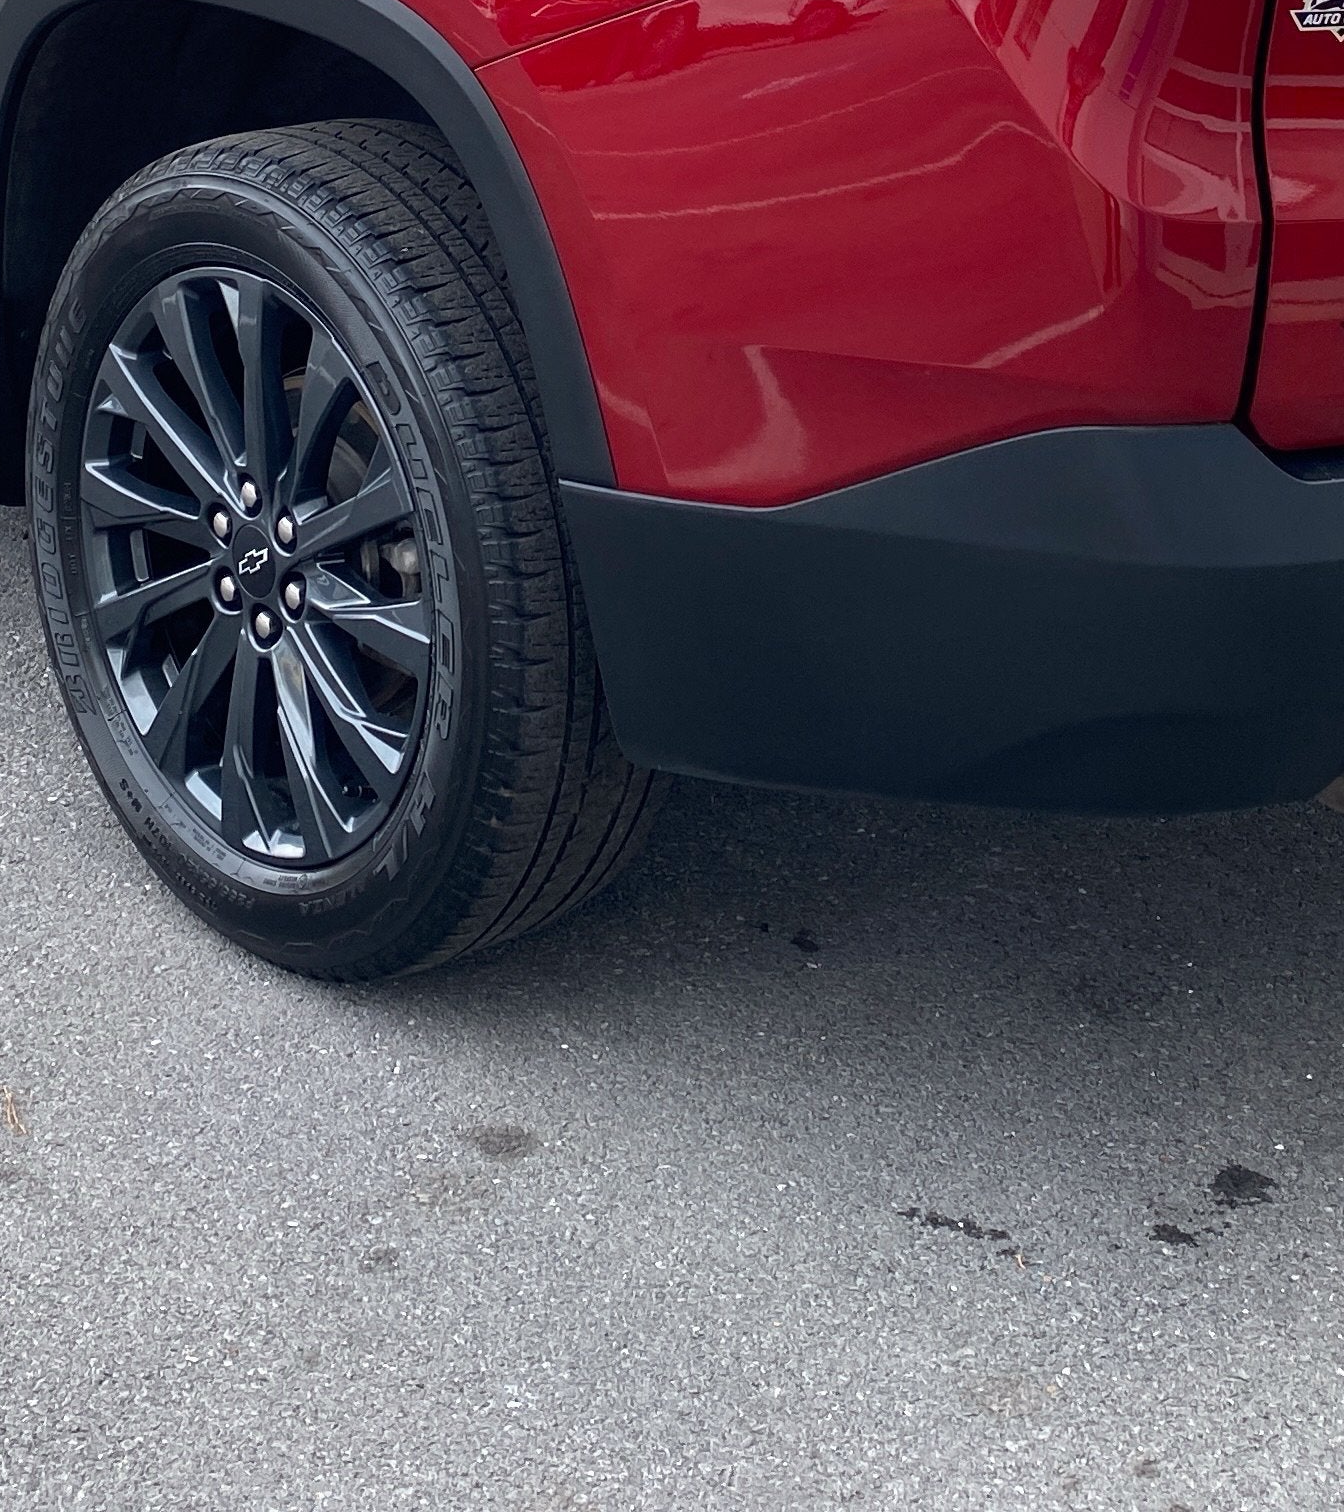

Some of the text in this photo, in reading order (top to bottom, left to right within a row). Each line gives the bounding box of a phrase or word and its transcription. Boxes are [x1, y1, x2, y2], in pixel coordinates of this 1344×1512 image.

[1303, 12, 1341, 26] AUTO
[33, 298, 97, 717] BRIDGESTONE
[365, 360, 454, 740] DUELER
